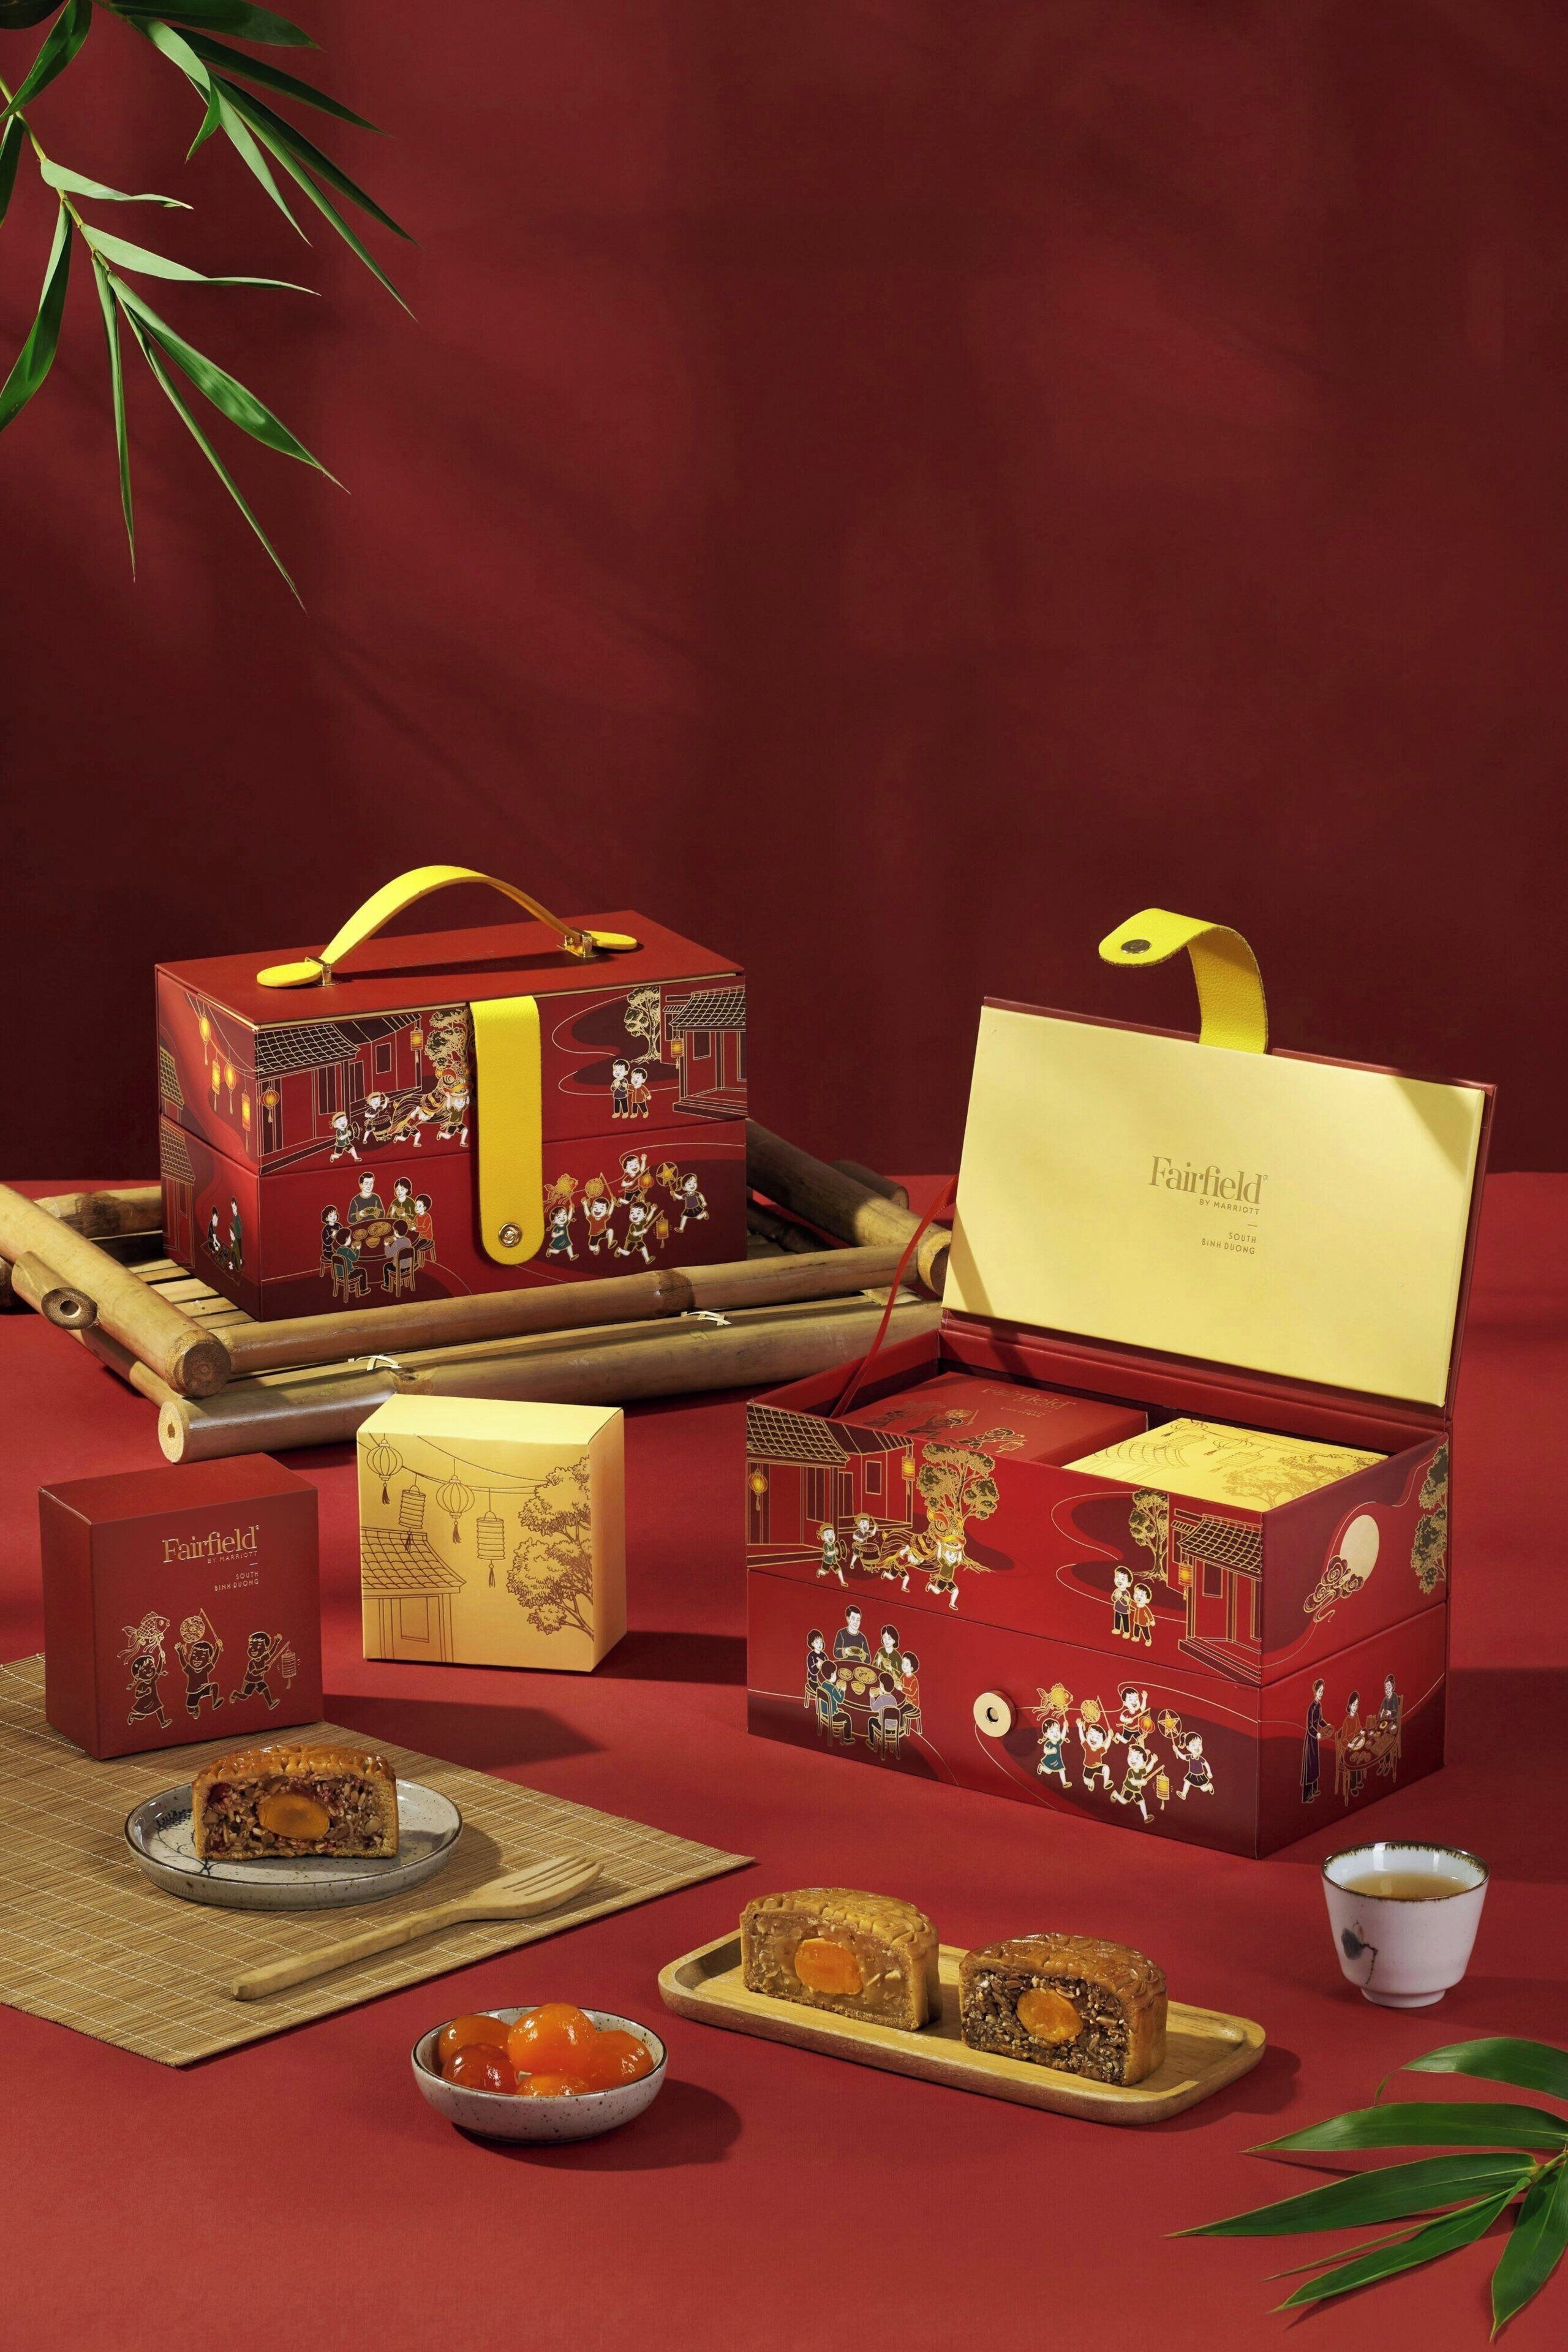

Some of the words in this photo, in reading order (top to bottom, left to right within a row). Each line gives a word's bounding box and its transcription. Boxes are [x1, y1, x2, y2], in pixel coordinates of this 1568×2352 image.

[1213, 1201, 1261, 1215] MARRIOTT
[1229, 1232, 1257, 1243] SOUTH
[1201, 1238, 1221, 1248] BINH
[1224, 1242, 1256, 1255] DUONG
[219, 1550, 258, 1562] MARRIOTT
[235, 1570, 258, 1580] SOUTH
[233, 1578, 260, 1588] DUONG
